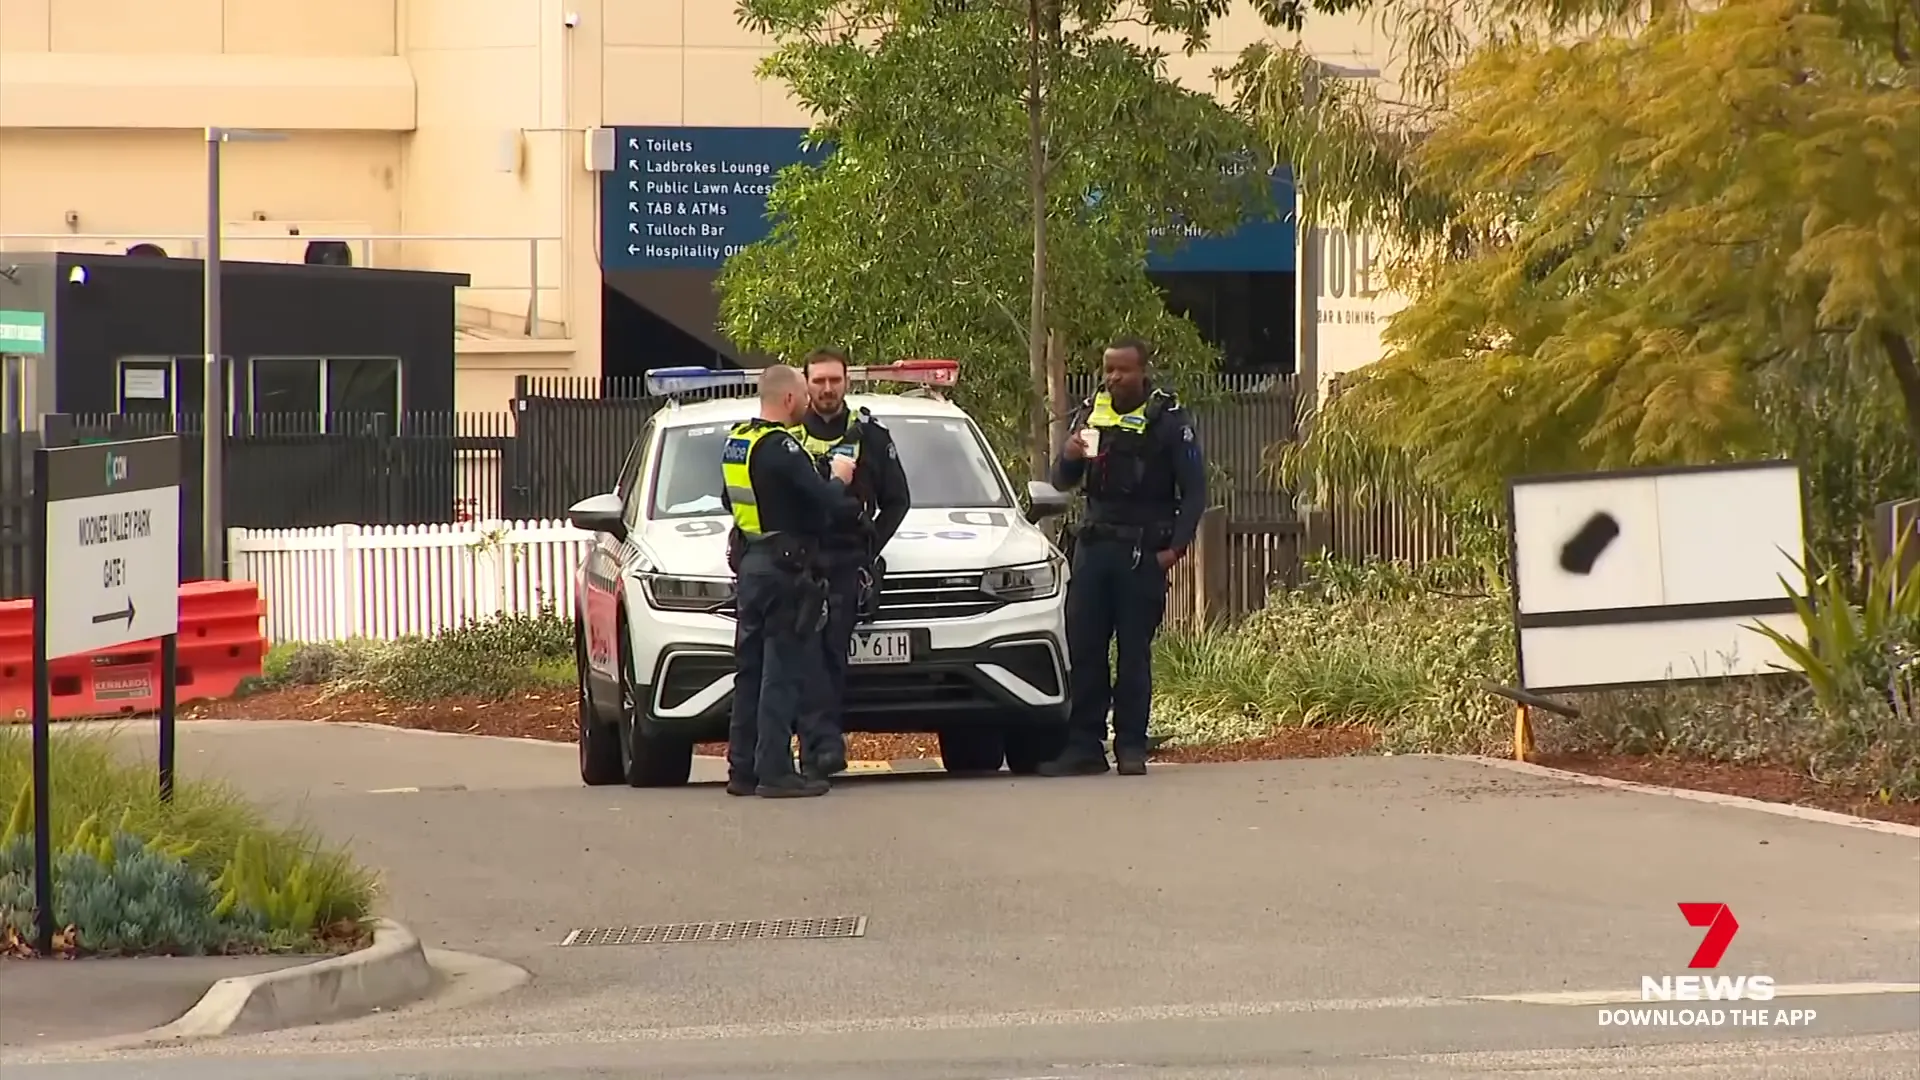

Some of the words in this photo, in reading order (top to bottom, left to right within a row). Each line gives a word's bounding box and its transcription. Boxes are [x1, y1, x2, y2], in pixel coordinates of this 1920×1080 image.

[646, 138, 693, 152] Toilets
[646, 160, 717, 174] Ladbrokes
[721, 160, 770, 177] Lounge
[646, 181, 689, 194] Public
[693, 181, 729, 194] Lawn
[733, 181, 777, 194] Access
[646, 202, 672, 215] TAB
[676, 202, 687, 215] &
[691, 202, 728, 215] ATMs
[646, 223, 696, 236] Tulloch
[701, 223, 725, 236] Bar
[645, 244, 720, 260] Hospitality
[79, 514, 107, 547] MOONEE
[108, 510, 133, 542] VALLEY
[133, 508, 151, 540] PARK
[103, 557, 121, 588] GATE
[121, 557, 126, 585] 1
